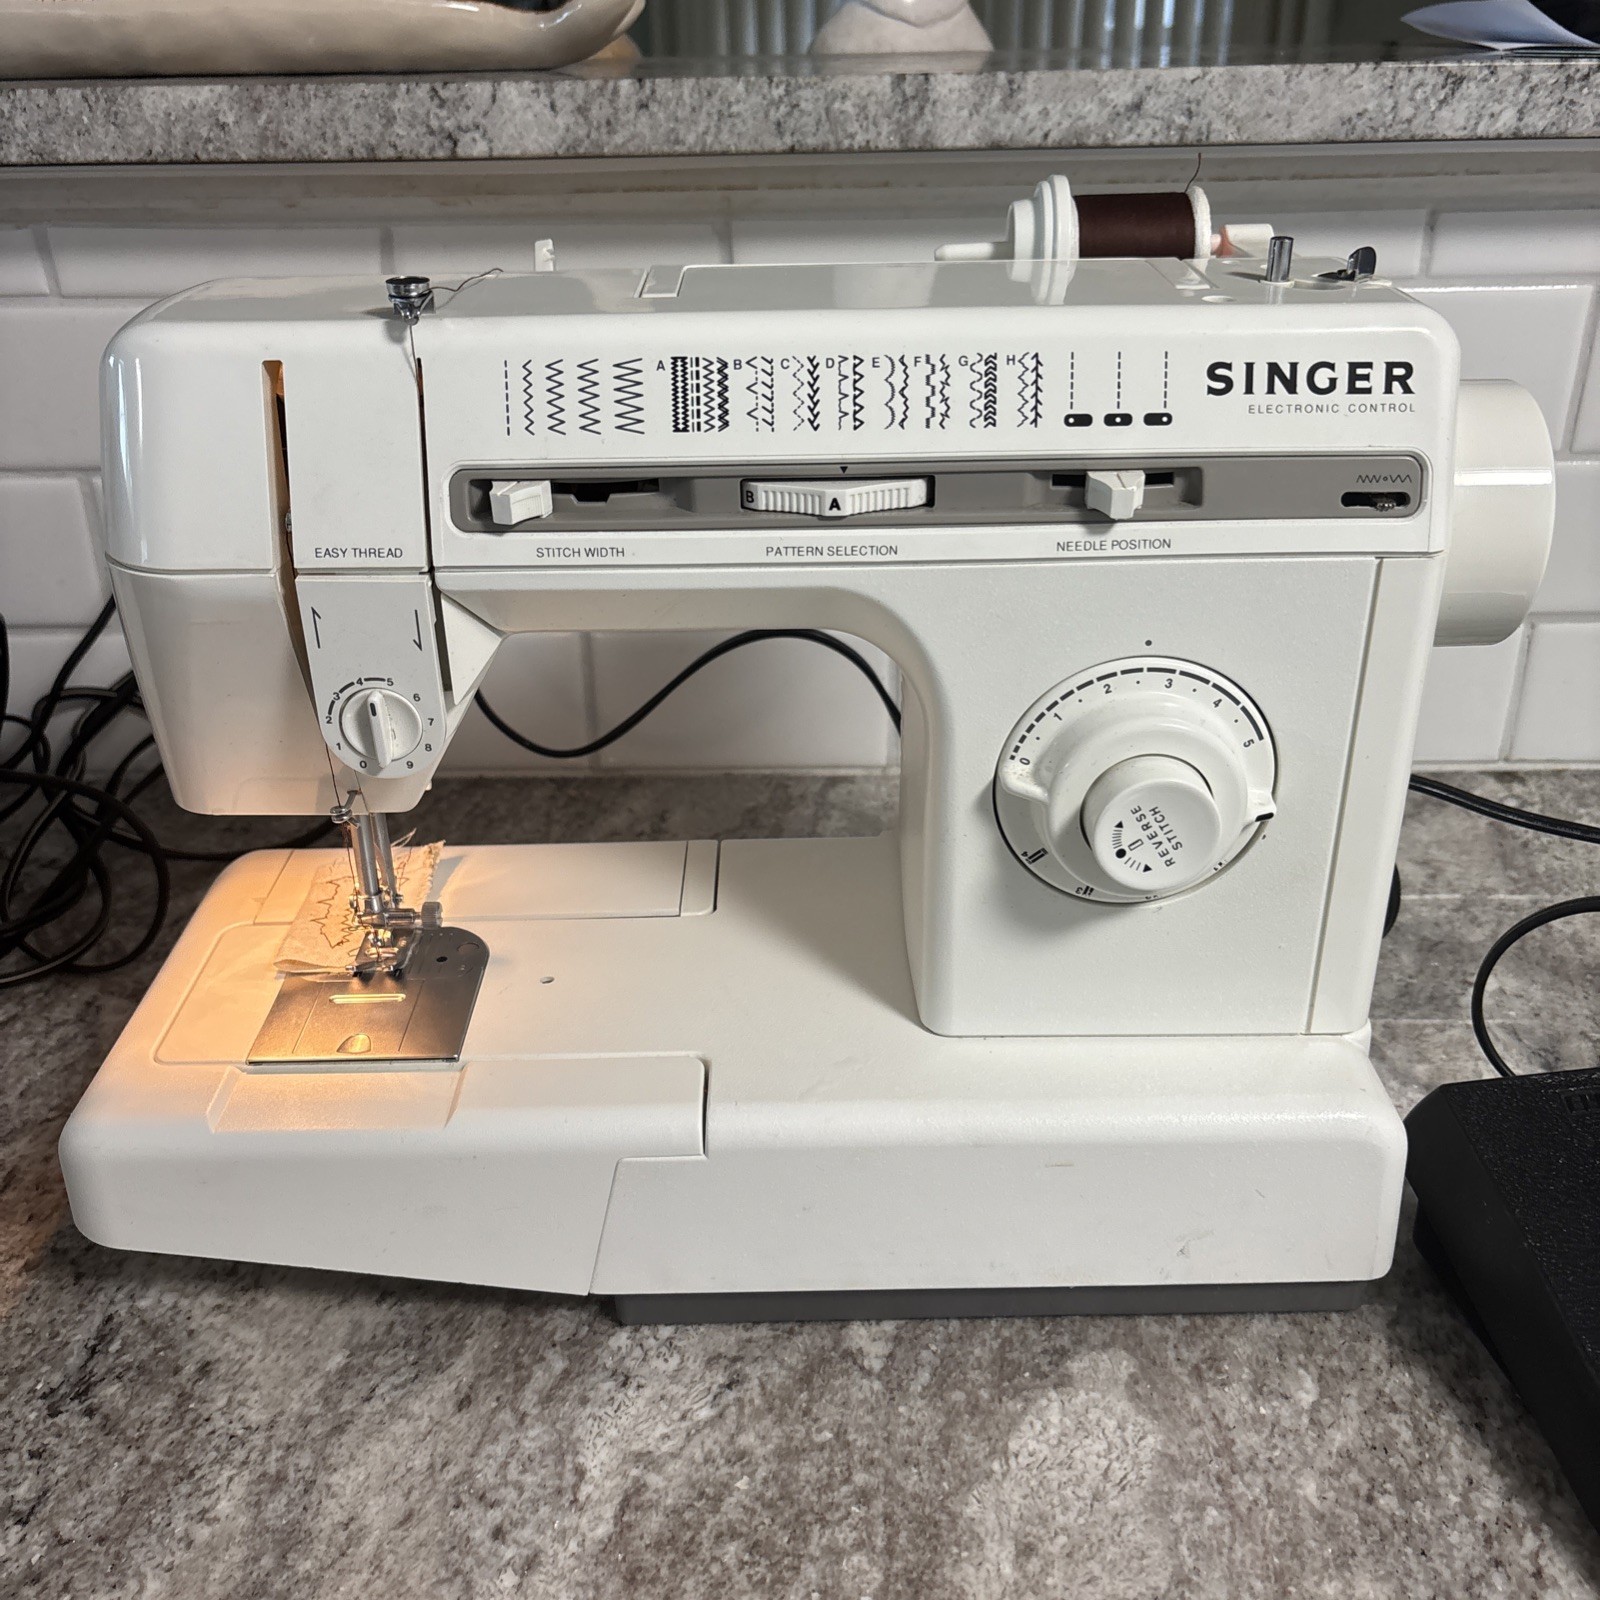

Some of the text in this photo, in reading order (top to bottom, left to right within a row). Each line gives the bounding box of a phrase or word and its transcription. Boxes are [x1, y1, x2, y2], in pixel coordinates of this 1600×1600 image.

[656, 354, 1016, 371] A B C D E F G H
[1206, 361, 1415, 396] SINGER
[1248, 402, 1416, 415] ELECTRONIC CONTROL
[746, 490, 755, 504] B
[828, 498, 841, 511] A
[766, 545, 898, 557] PATTERN SELECTION
[1056, 538, 1172, 552] NEEDLE POSITION
[314, 547, 404, 559] EASY THREAD
[536, 547, 625, 558] STITCH WIDTH
[325, 677, 434, 769] 0 1 2 3 4 5 6 7 8 9
[1019, 678, 1255, 766] 0 1 2 3 4 5
[1148, 806, 1183, 851] STITCH
[1130, 805, 1176, 867] REVERSE
